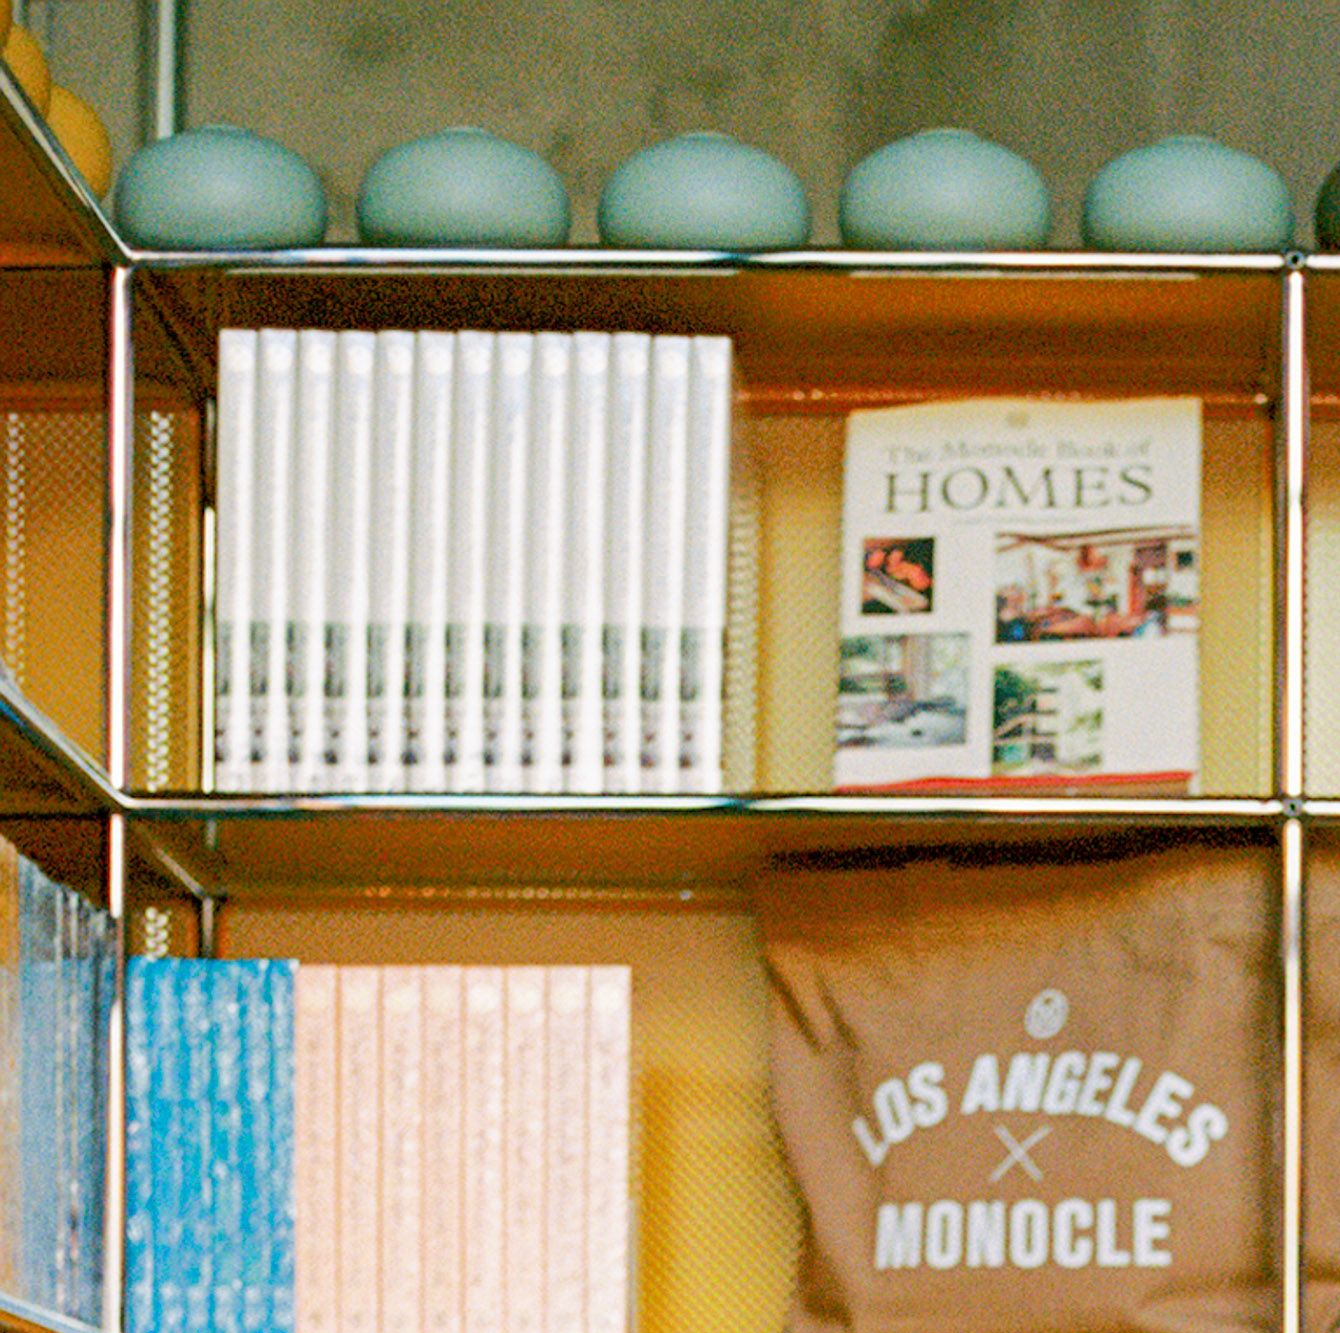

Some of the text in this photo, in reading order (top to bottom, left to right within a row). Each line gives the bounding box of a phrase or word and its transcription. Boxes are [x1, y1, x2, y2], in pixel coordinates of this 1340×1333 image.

[885, 463, 1154, 514] HOMES
[851, 1049, 1230, 1168] LOS ANGELES
[873, 1198, 1174, 1271] MONOCLE
